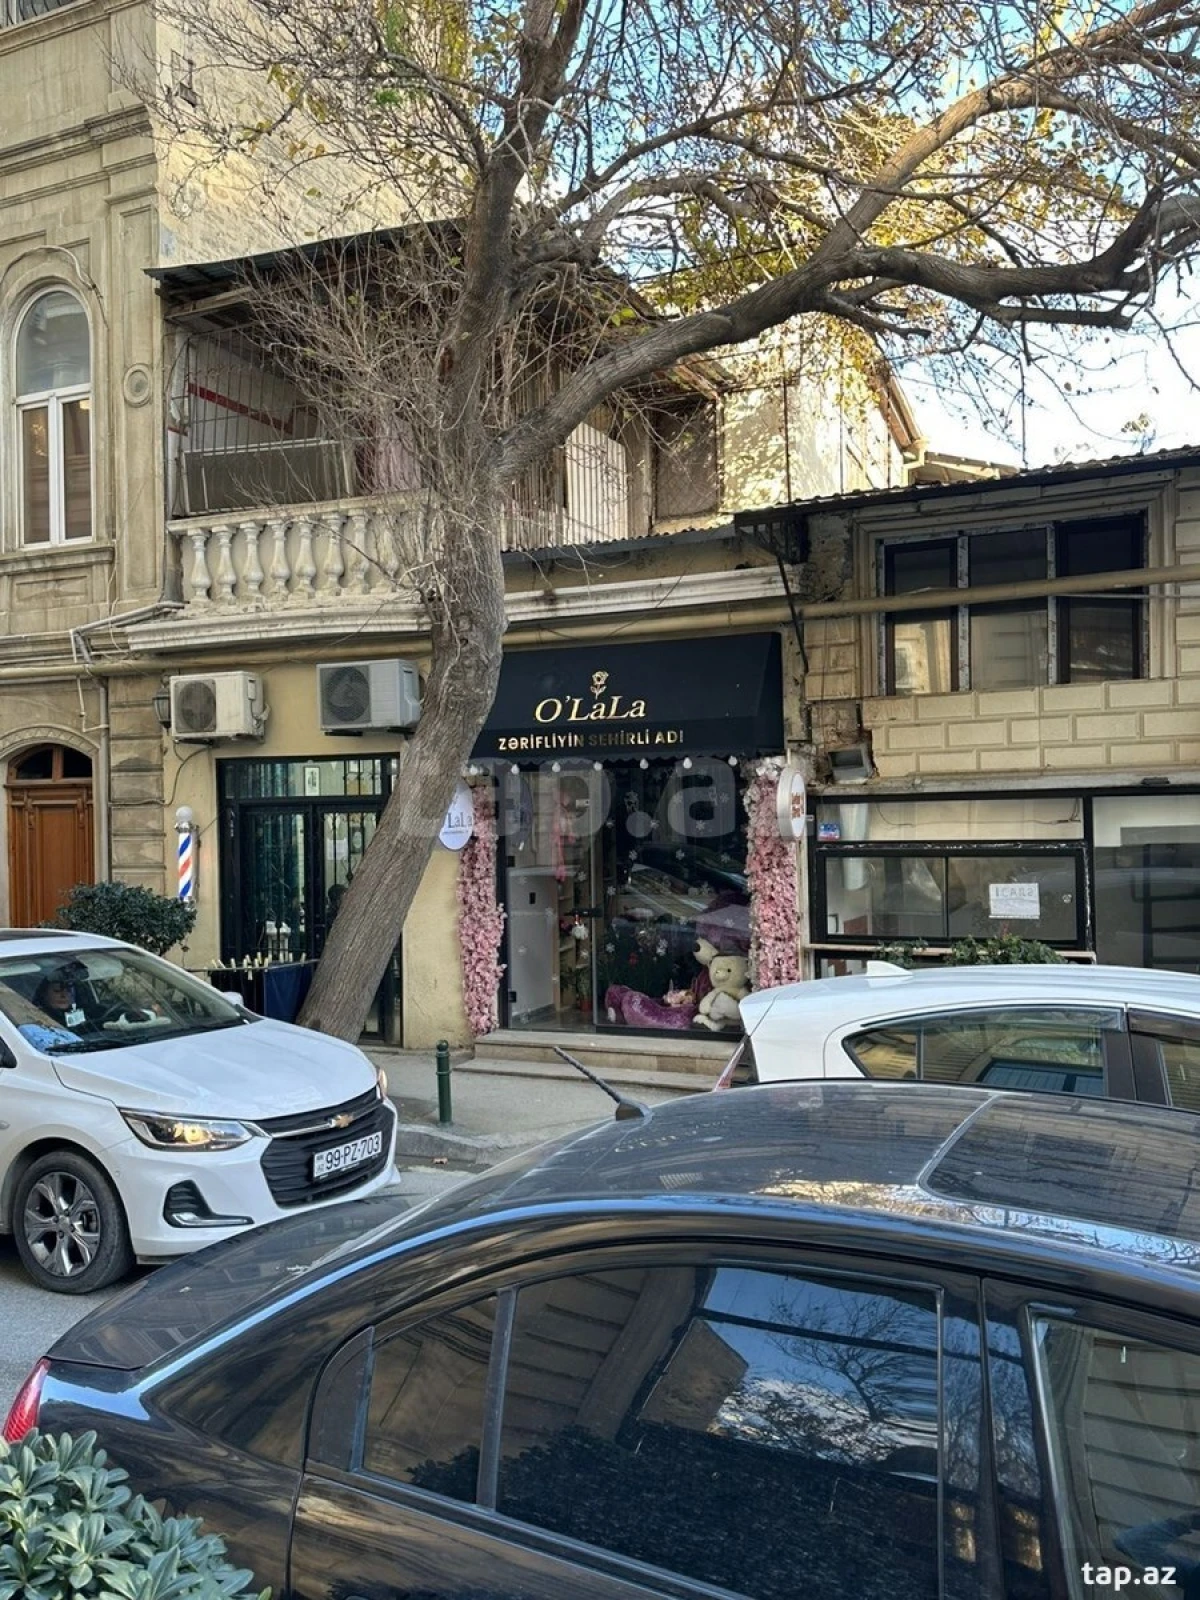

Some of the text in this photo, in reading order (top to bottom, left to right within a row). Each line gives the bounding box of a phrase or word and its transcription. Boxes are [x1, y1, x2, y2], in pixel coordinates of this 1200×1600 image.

[534, 695, 647, 723] O'LaLa
[498, 733, 585, 750] ZƏRİFLİYİN
[655, 729, 684, 744] ADI
